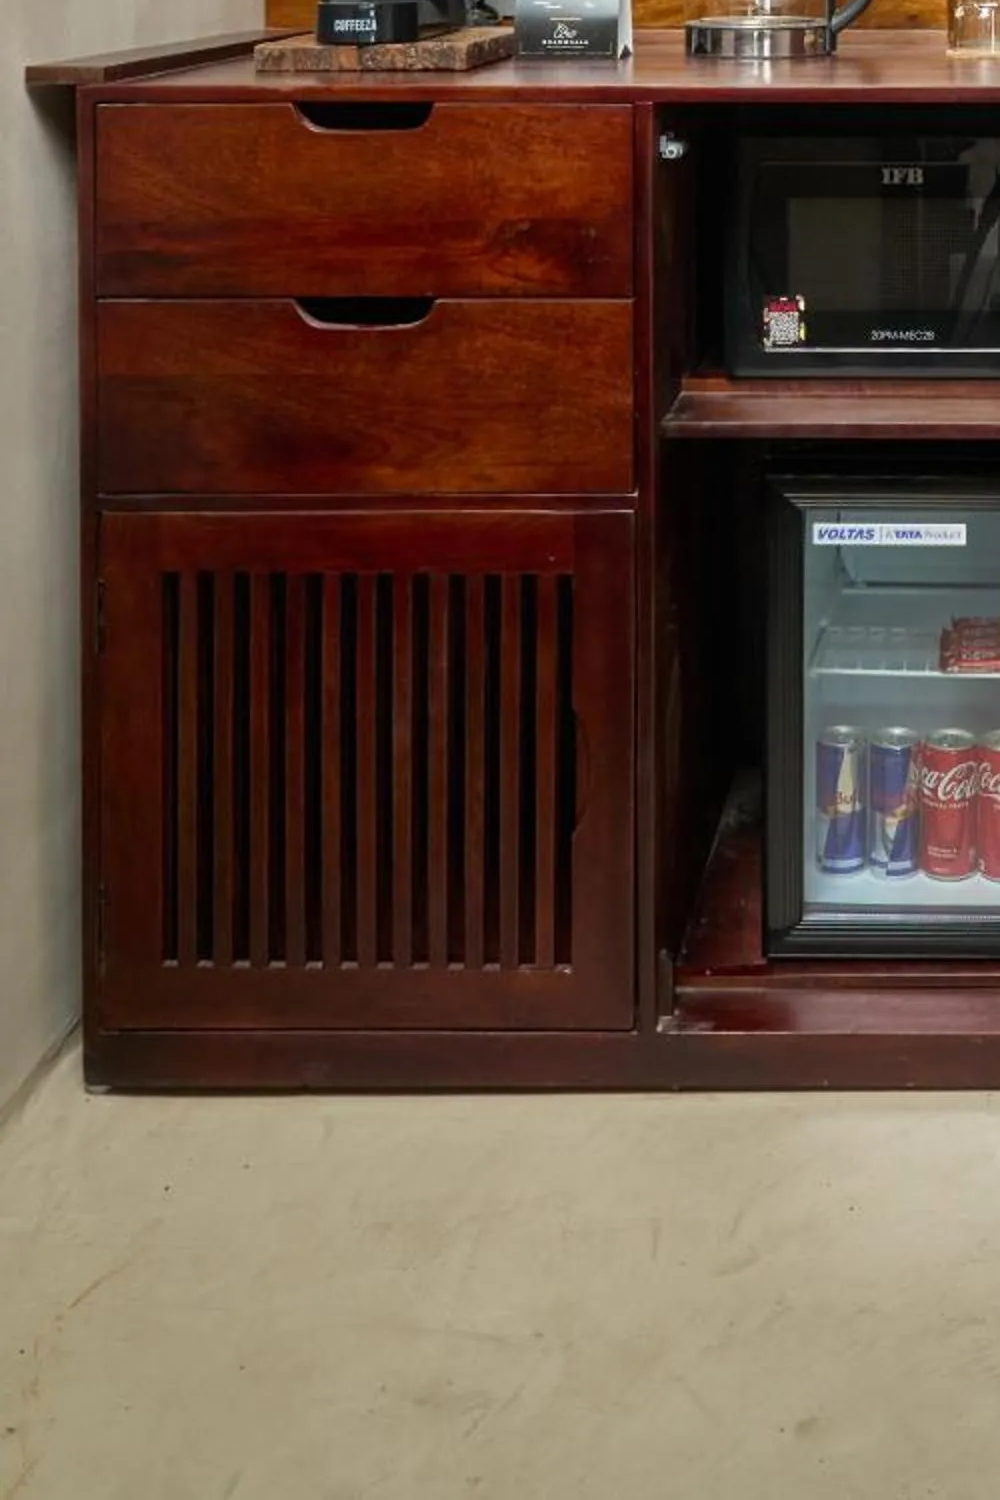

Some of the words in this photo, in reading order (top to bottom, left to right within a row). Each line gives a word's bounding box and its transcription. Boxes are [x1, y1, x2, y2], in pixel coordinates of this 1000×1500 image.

[881, 167, 925, 185] IFB
[818, 528, 875, 540] VOLTAS
[895, 530, 922, 539] TATA
